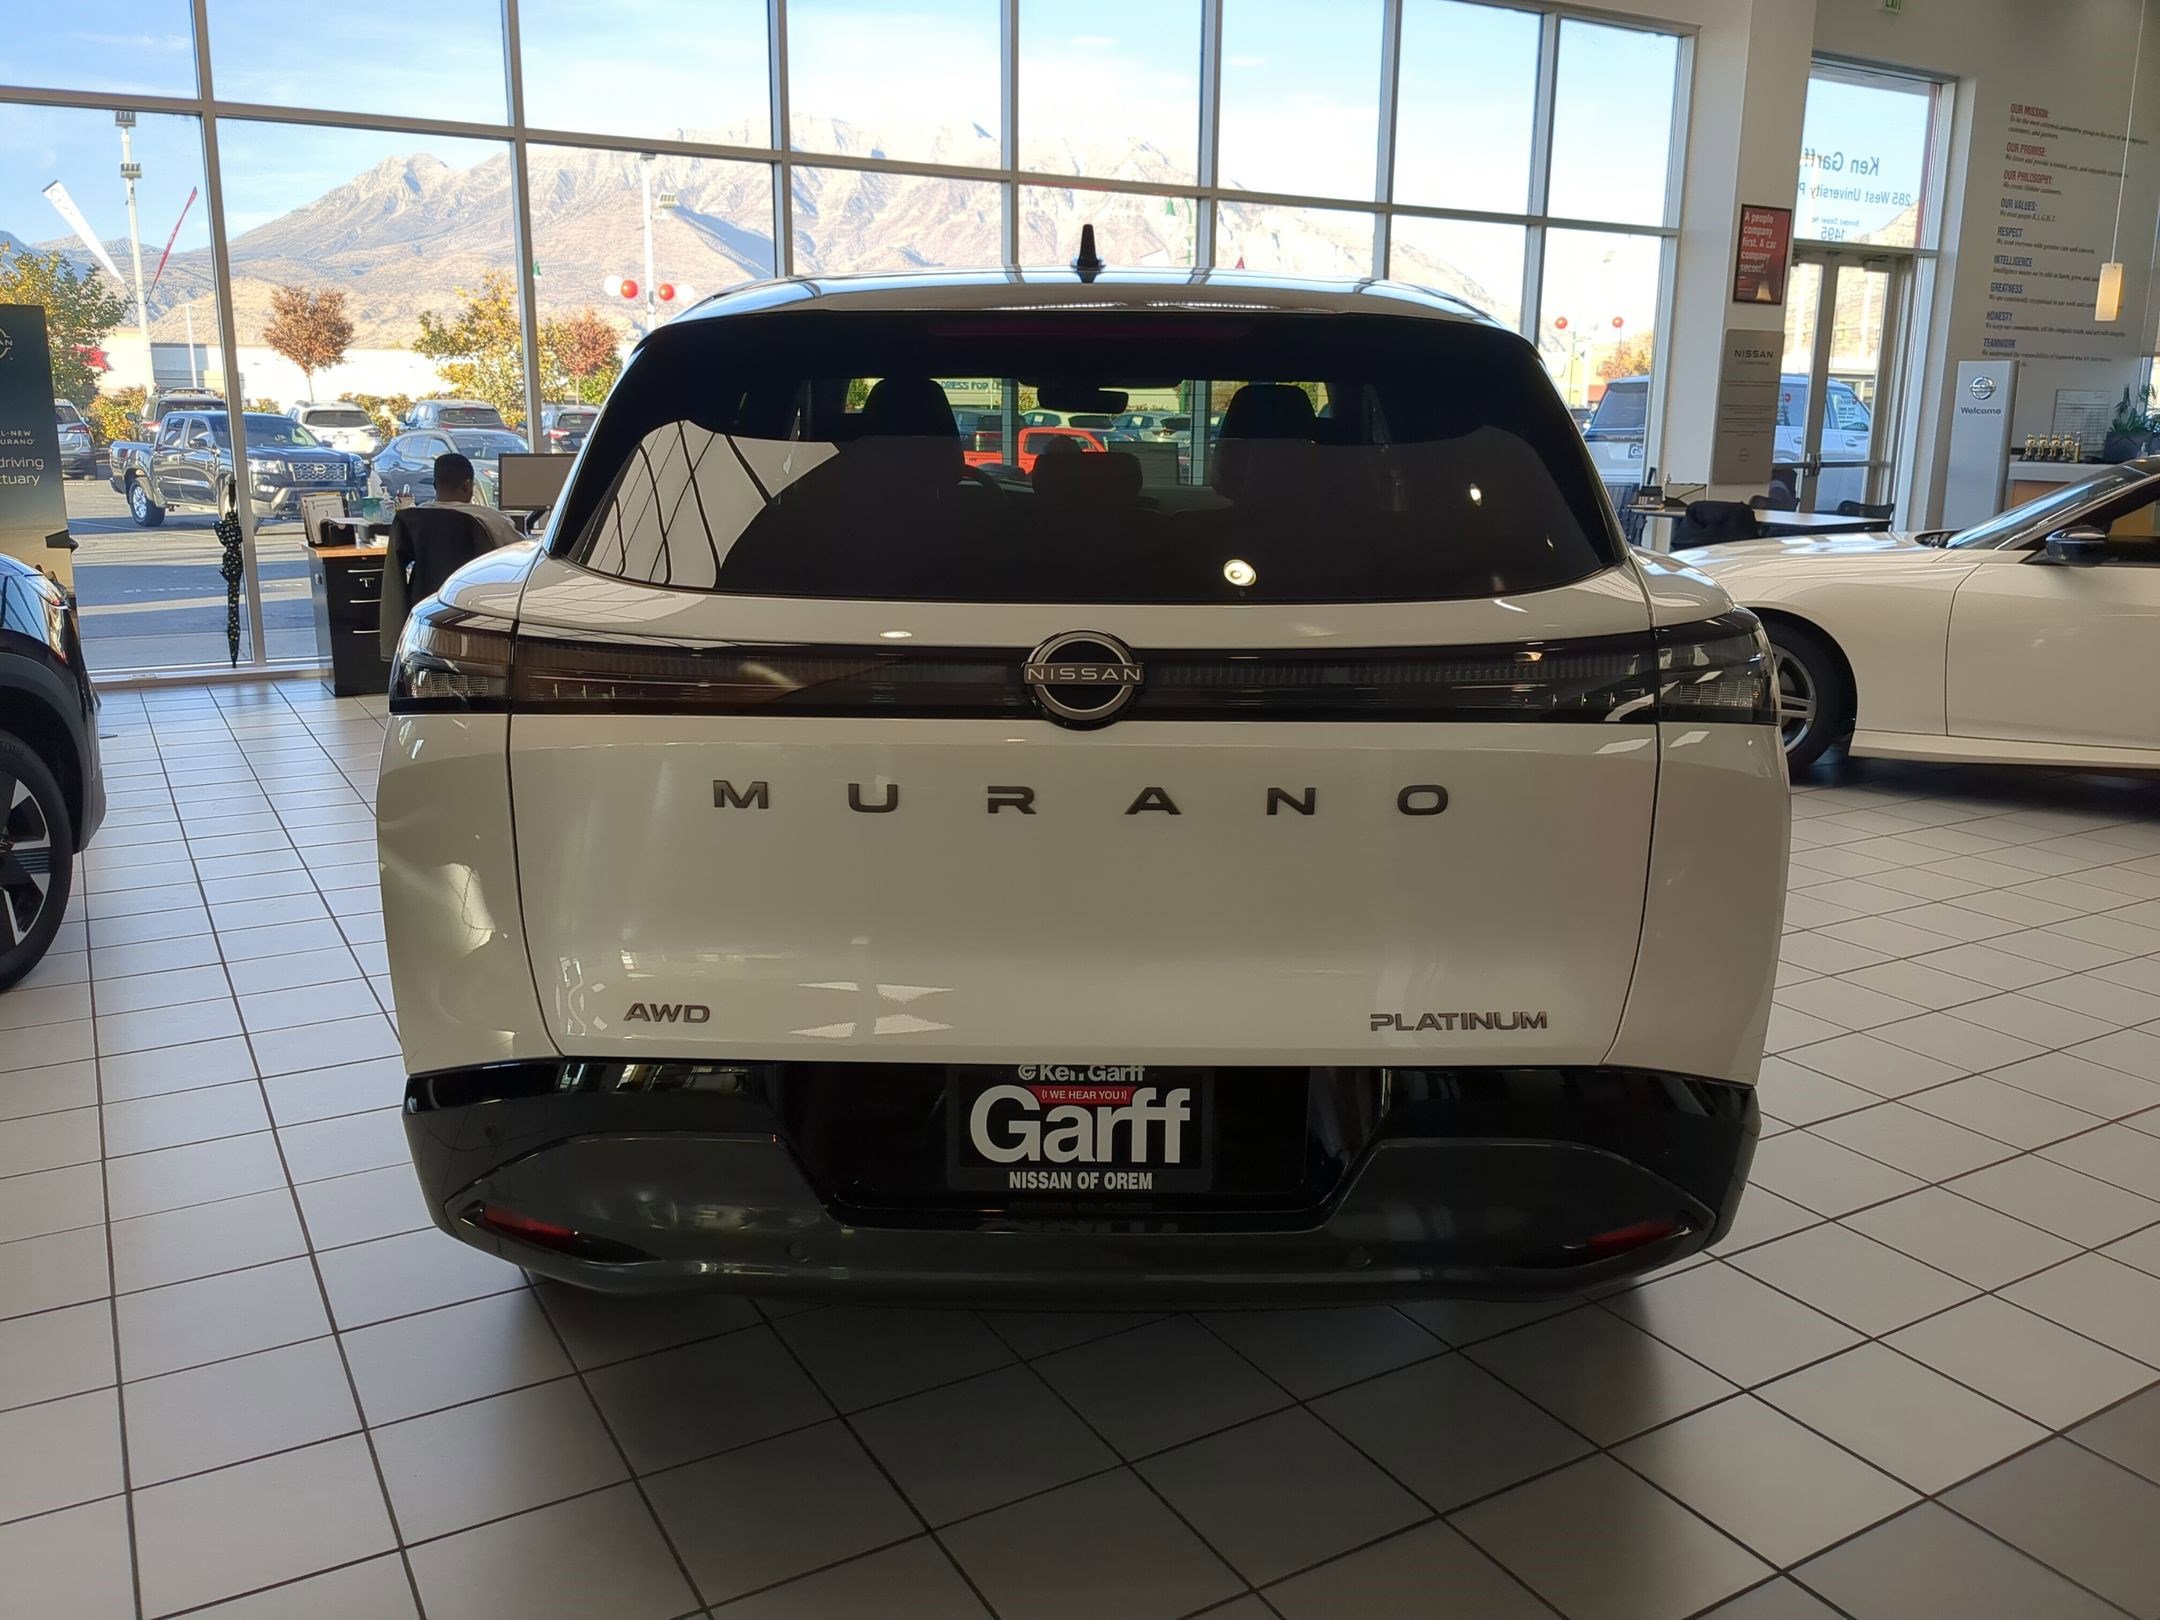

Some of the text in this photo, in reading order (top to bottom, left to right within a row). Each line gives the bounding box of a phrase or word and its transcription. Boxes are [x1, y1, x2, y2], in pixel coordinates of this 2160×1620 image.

[1743, 226, 1773, 238] company
[1741, 251, 1771, 263] company
[1734, 350, 1774, 358] NISSAN
[1960, 407, 2002, 415] Welcome
[1028, 668, 1140, 681] NISSAN
[713, 779, 1449, 815] MURANO
[623, 1002, 711, 1023] AWD
[1370, 1011, 1548, 1032] PLATINUM
[1049, 1090, 1120, 1100] WE HEAR YOU
[969, 1084, 1191, 1164] Garff
[1009, 1171, 1153, 1190] NISSAN OF OREM
